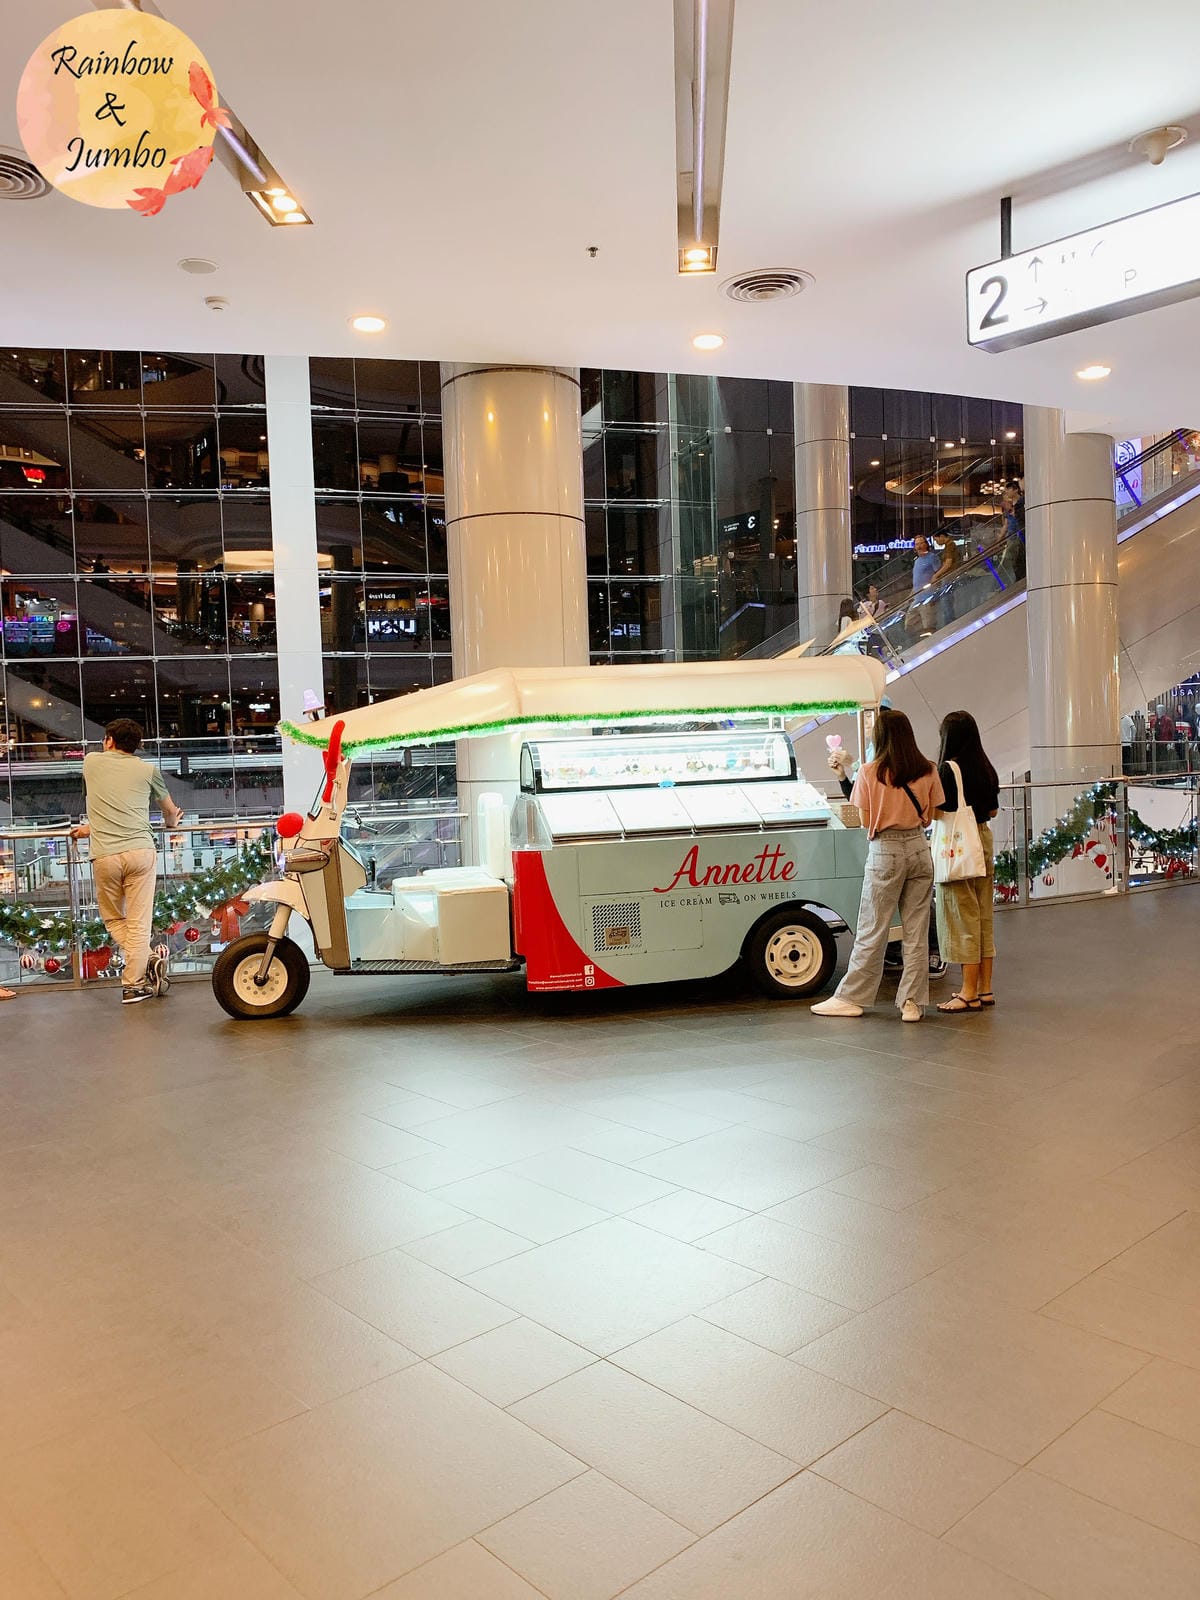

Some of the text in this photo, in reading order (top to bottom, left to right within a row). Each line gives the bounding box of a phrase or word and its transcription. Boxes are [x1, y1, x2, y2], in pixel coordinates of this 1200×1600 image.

[979, 275, 1009, 331] 2
[1171, 688, 1194, 697] USA
[652, 843, 799, 893] Annette
[660, 891, 797, 908] ICE CREAM ON WHEELS
